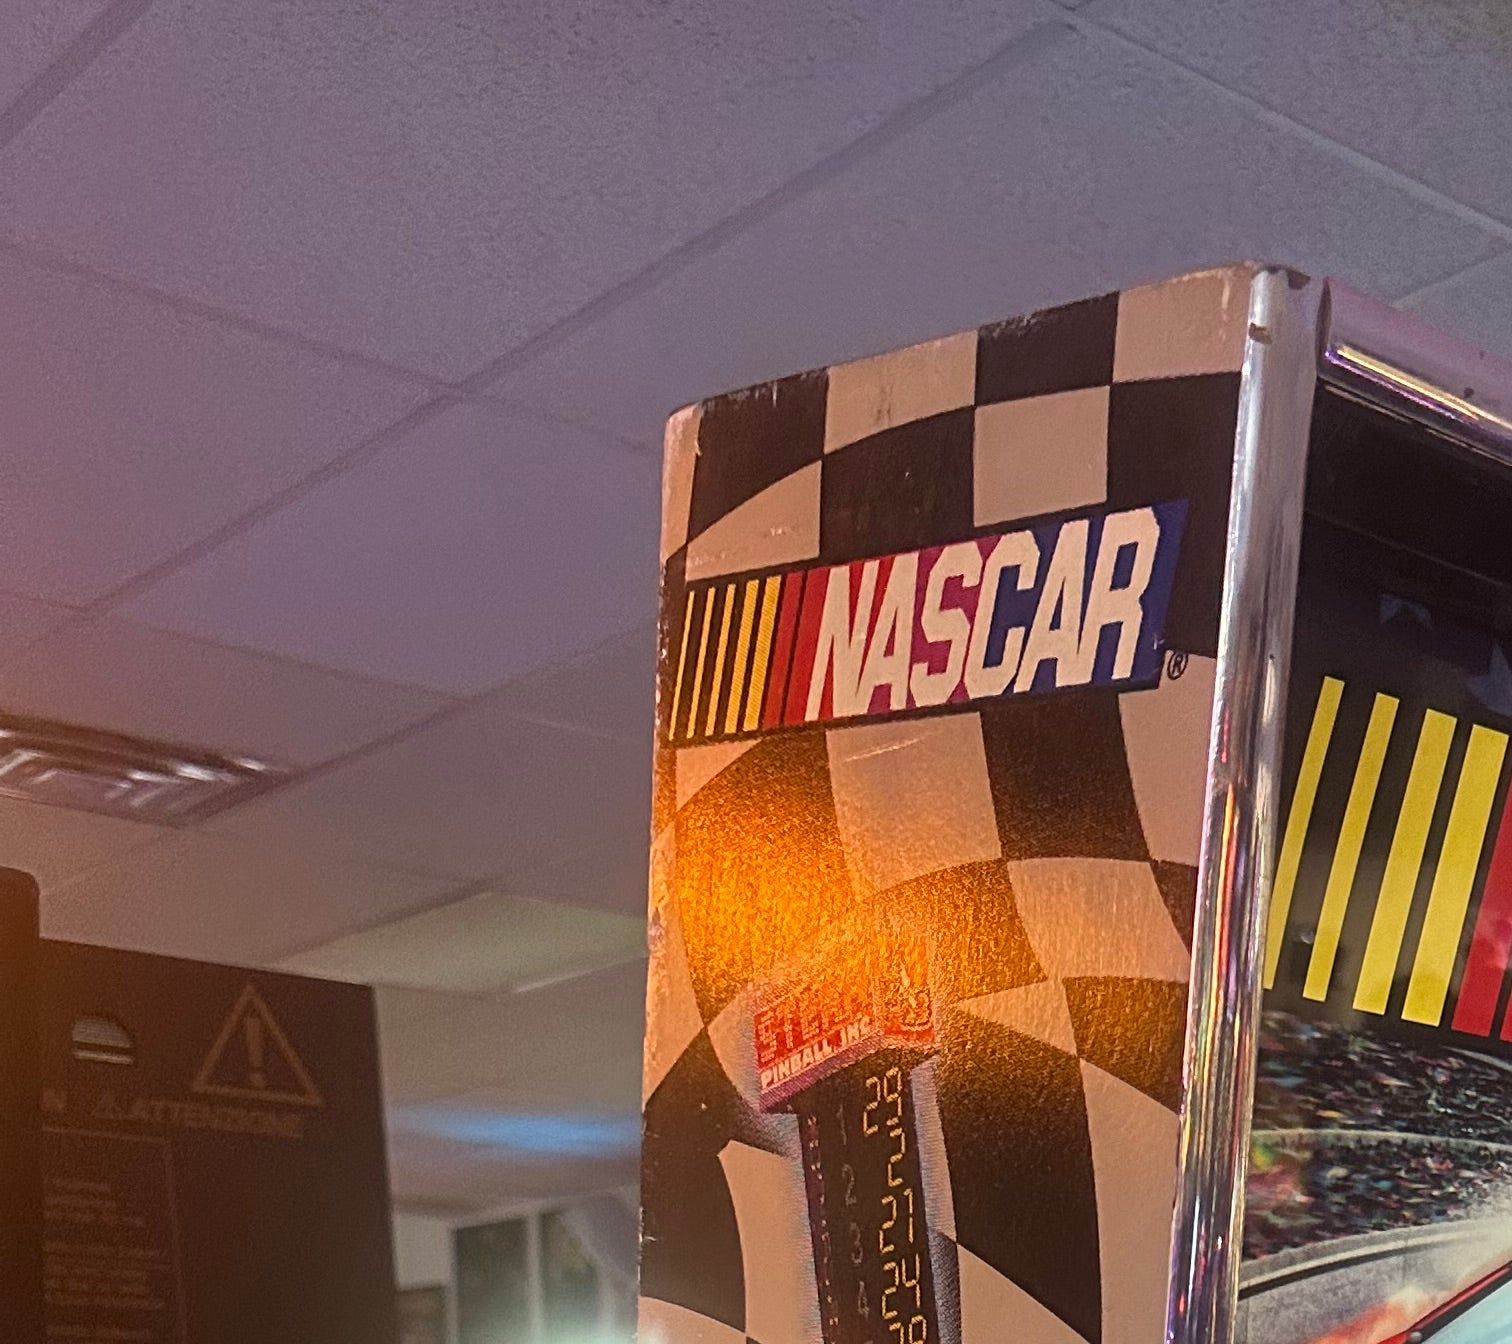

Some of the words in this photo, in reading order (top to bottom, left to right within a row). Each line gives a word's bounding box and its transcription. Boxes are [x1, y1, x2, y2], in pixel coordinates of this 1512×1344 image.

[805, 506, 1160, 721] NASCAR
[836, 1104, 847, 1146] 1
[863, 1067, 902, 1138] 29
[841, 1163, 857, 1207] 2
[887, 1127, 905, 1188] 2
[850, 1222, 863, 1266] 3
[878, 1187, 914, 1255] 21
[857, 1280, 870, 1318] 4
[881, 1252, 921, 1320] 24
